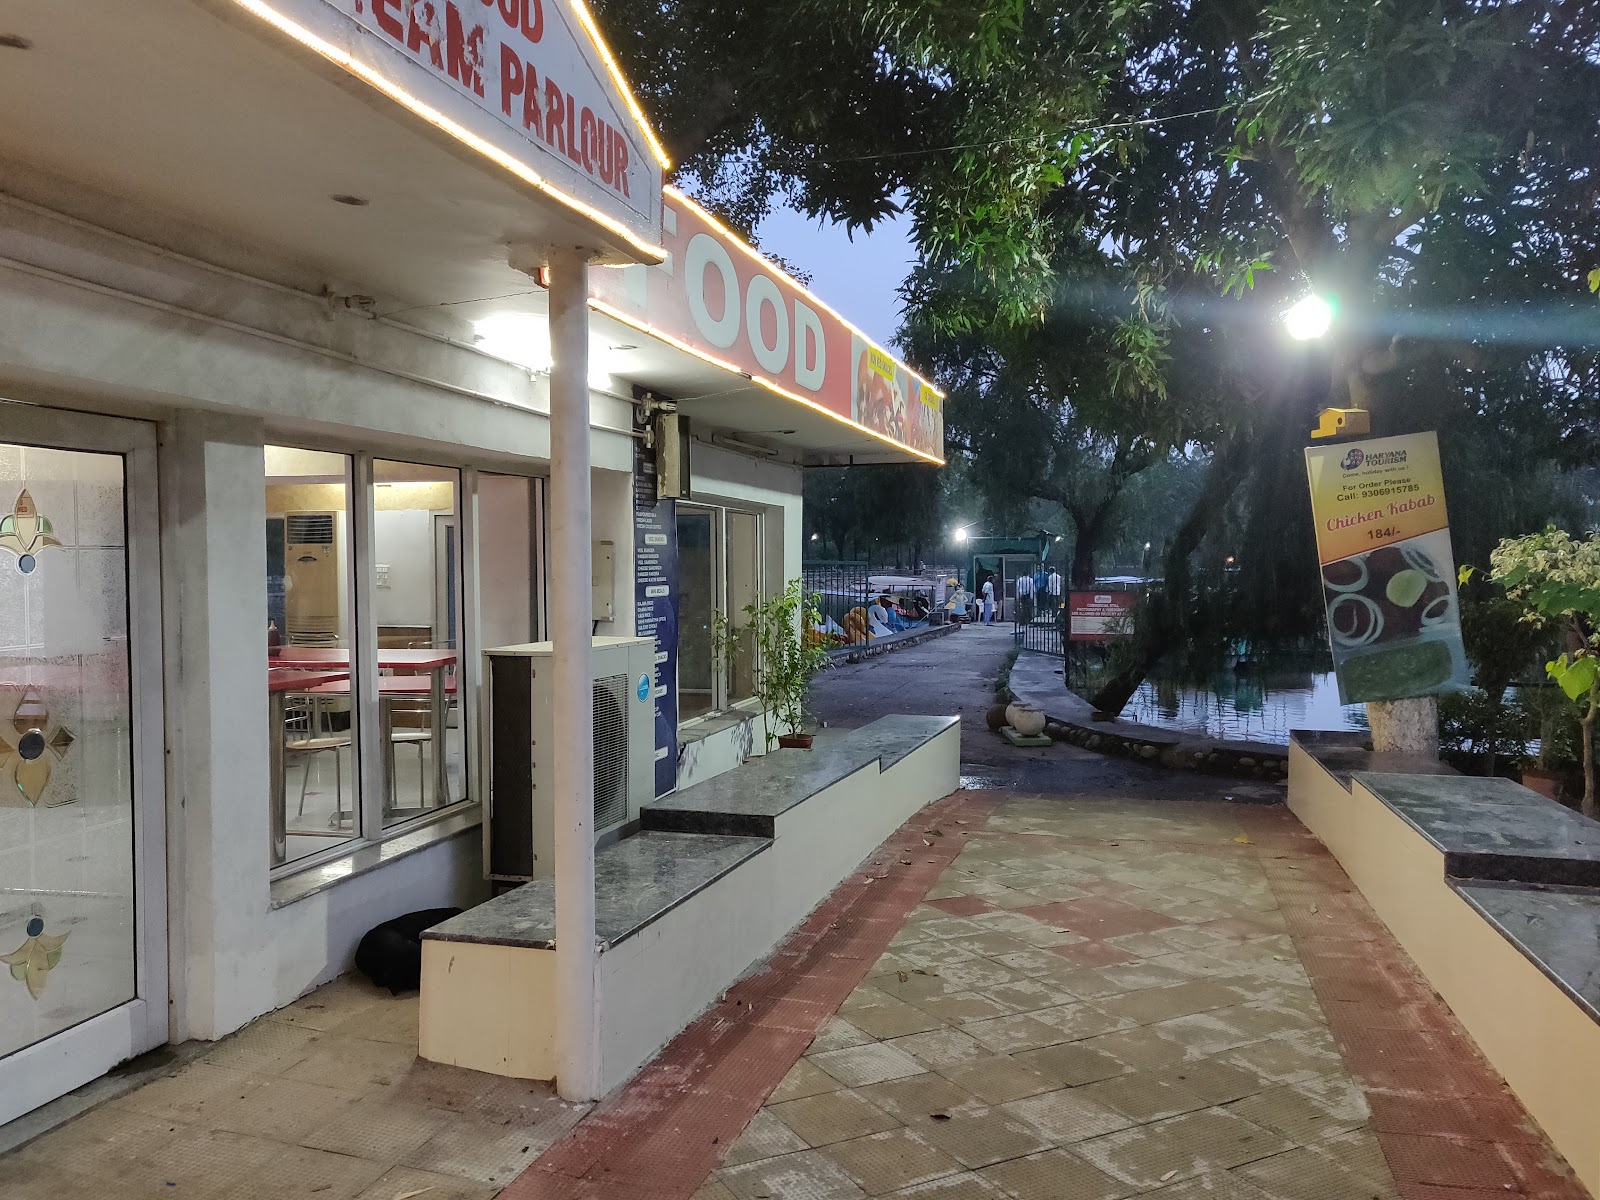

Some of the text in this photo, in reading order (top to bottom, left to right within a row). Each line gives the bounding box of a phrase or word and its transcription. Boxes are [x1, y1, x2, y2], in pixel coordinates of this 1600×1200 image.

[354, 0, 630, 199] EAM PARLOUR
[1365, 450, 1407, 460] HARYANA
[1366, 456, 1407, 466] TOURISM
[1362, 468, 1383, 476] holiday
[1358, 481, 1382, 489] Order
[1384, 478, 1412, 486] Please
[1336, 484, 1420, 502] Call: 9306915785
[1326, 494, 1436, 532] Chicken Kabab
[1367, 527, 1401, 540] 184/-
